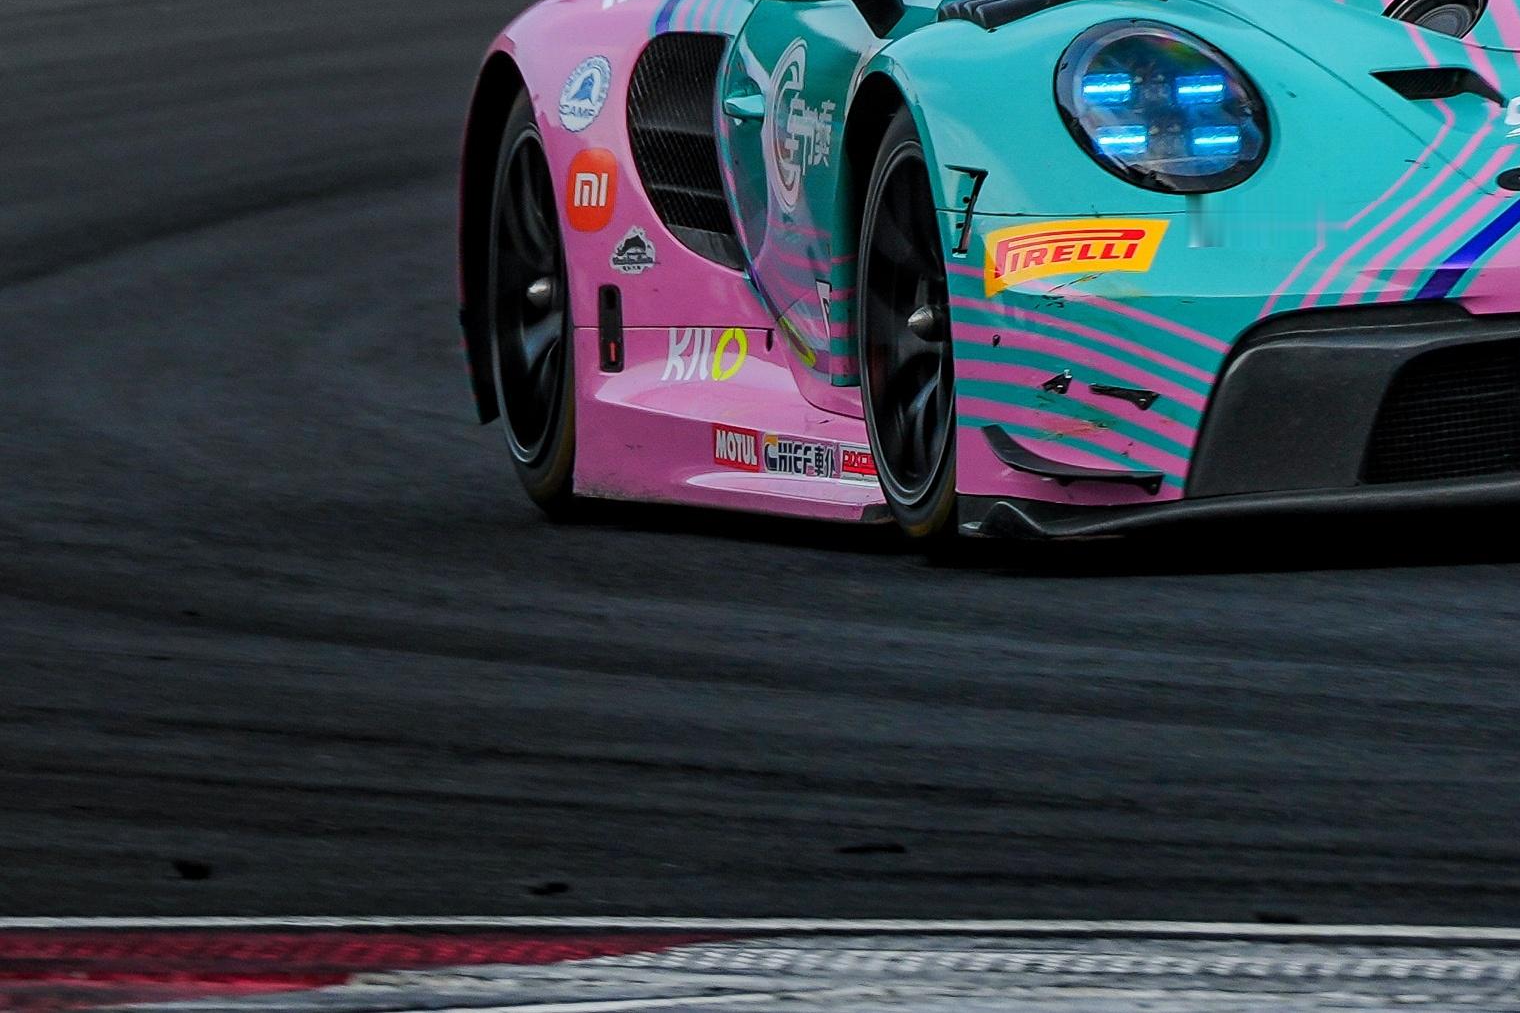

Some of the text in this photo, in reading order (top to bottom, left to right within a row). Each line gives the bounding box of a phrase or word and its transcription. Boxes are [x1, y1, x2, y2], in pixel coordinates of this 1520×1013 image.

[995, 229, 1146, 279] PIRELLI
[715, 429, 758, 466] MOTUL
[764, 434, 812, 475] CHIEF
